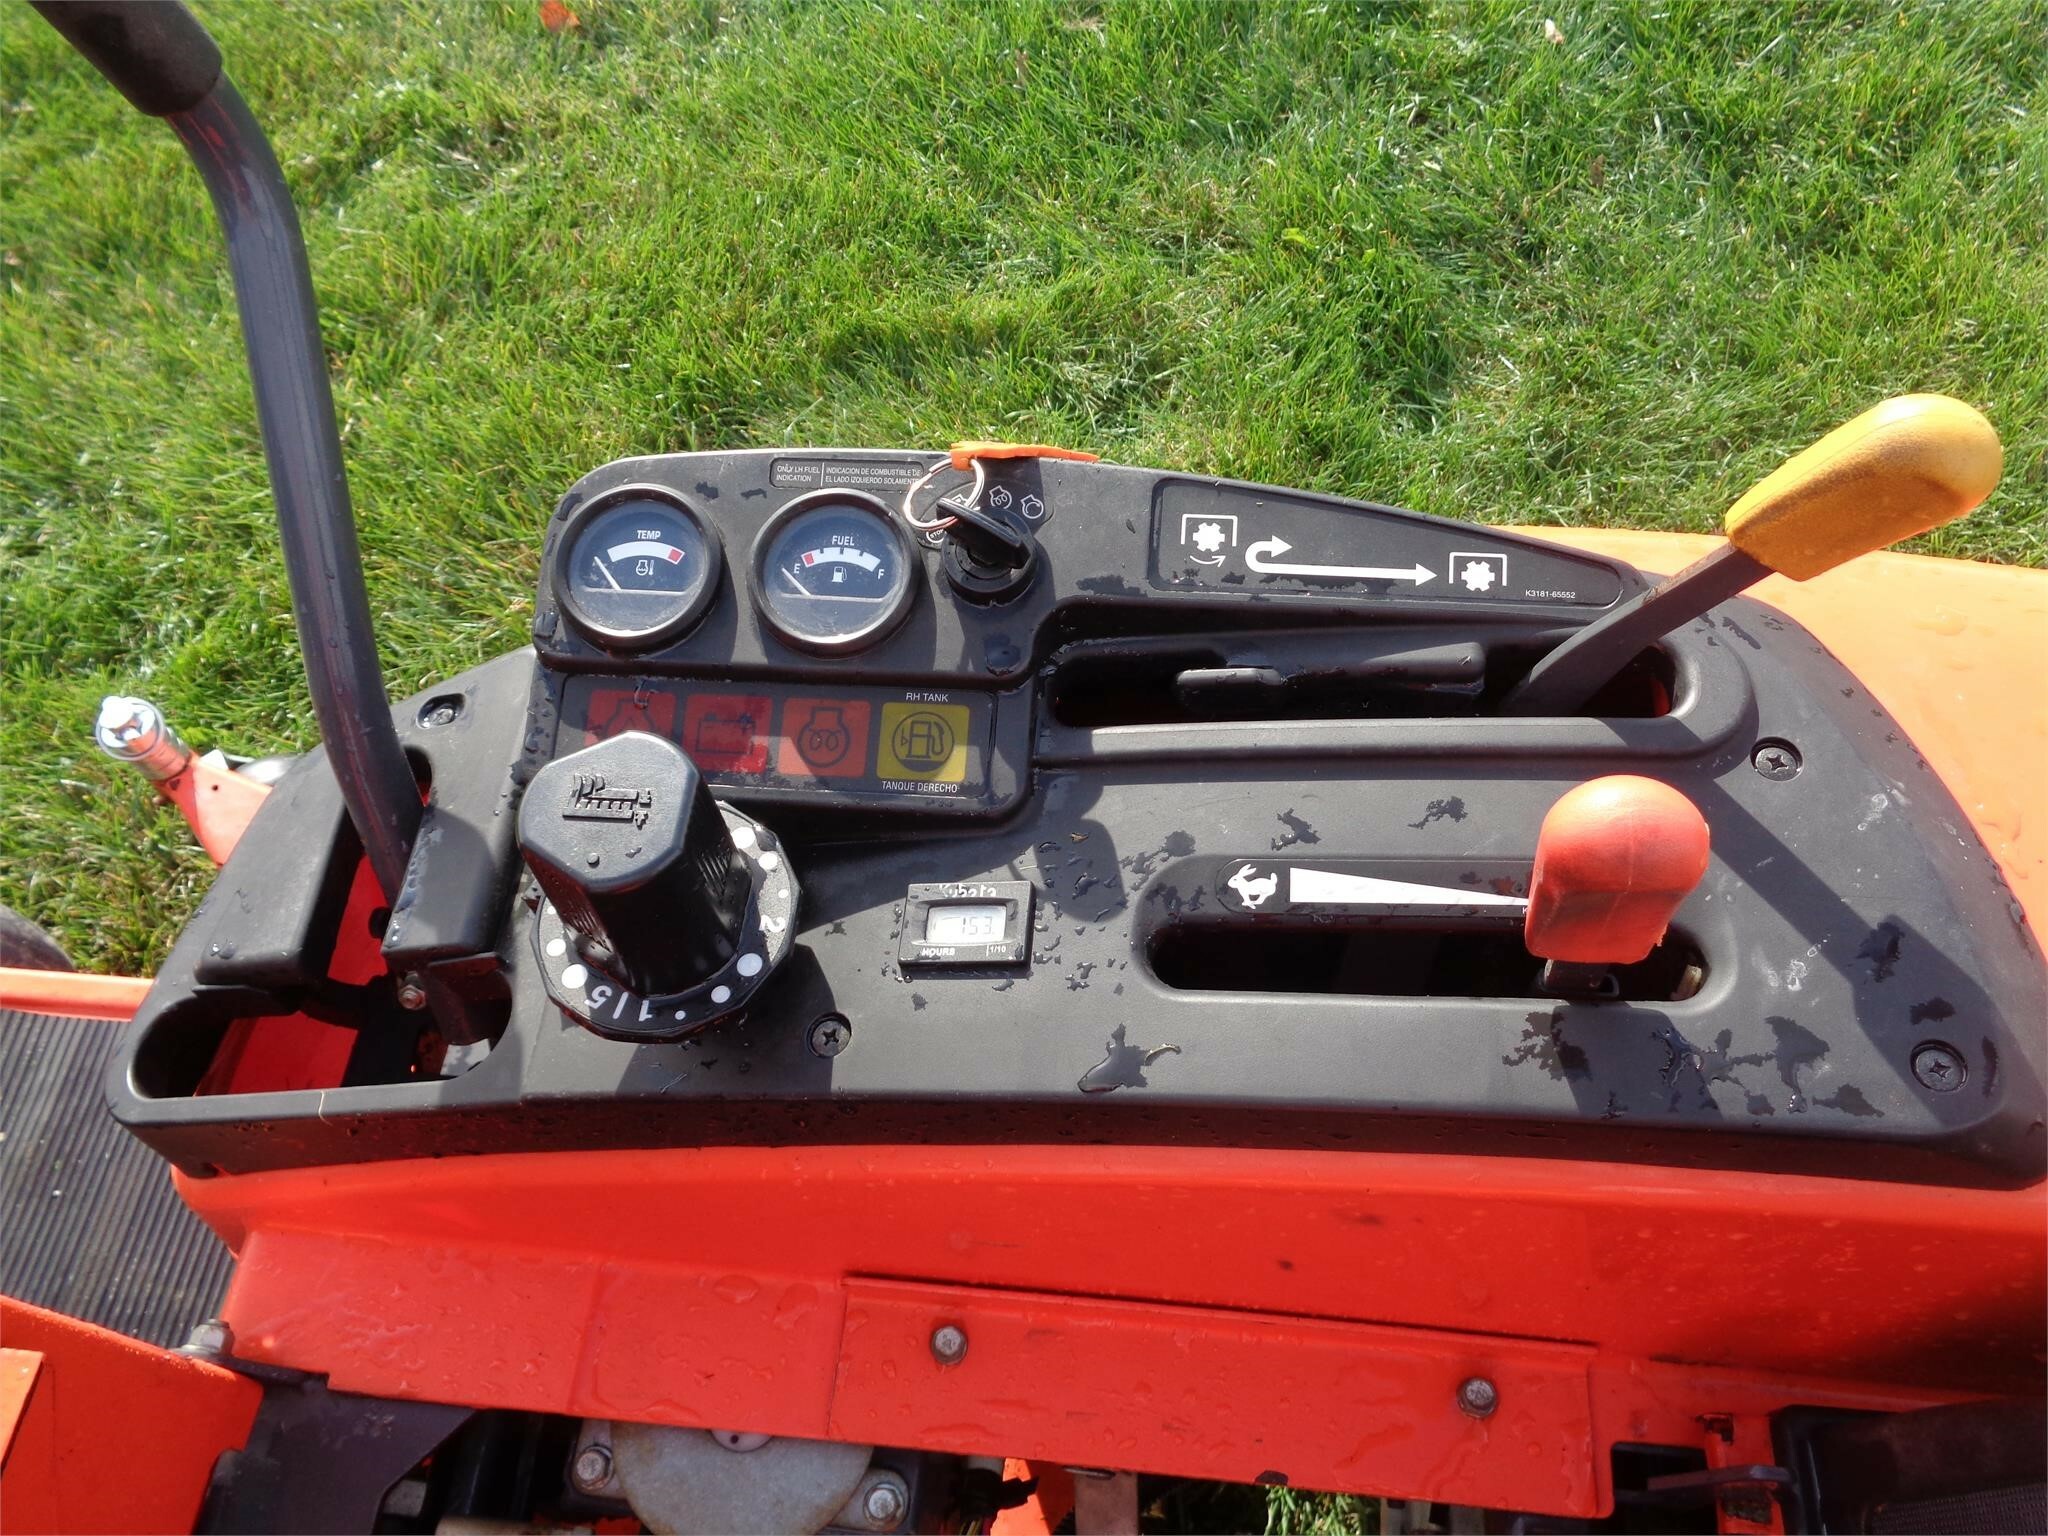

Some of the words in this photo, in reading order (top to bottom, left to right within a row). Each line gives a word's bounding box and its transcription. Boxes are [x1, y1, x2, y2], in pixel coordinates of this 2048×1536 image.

[776, 464, 794, 473] ONLY
[804, 466, 820, 474] FUEL
[826, 466, 860, 475] INDICACION
[870, 467, 911, 476] COMBUSTIBLE
[776, 474, 812, 482] INDICATION
[825, 475, 833, 483] EL
[834, 475, 850, 483] LADO
[851, 476, 883, 484] IZQUIERDO
[636, 529, 661, 540] TEMP
[831, 535, 855, 546] FUEL
[793, 563, 801, 574] E
[877, 568, 885, 580] F
[1525, 589, 1576, 599] K3181-65552
[905, 692, 921, 702] RH
[922, 693, 949, 702] TANK
[881, 780, 915, 791] TANQUE
[917, 782, 958, 793] DERECHO
[759, 914, 786, 933] 2
[921, 947, 956, 958] HOURS
